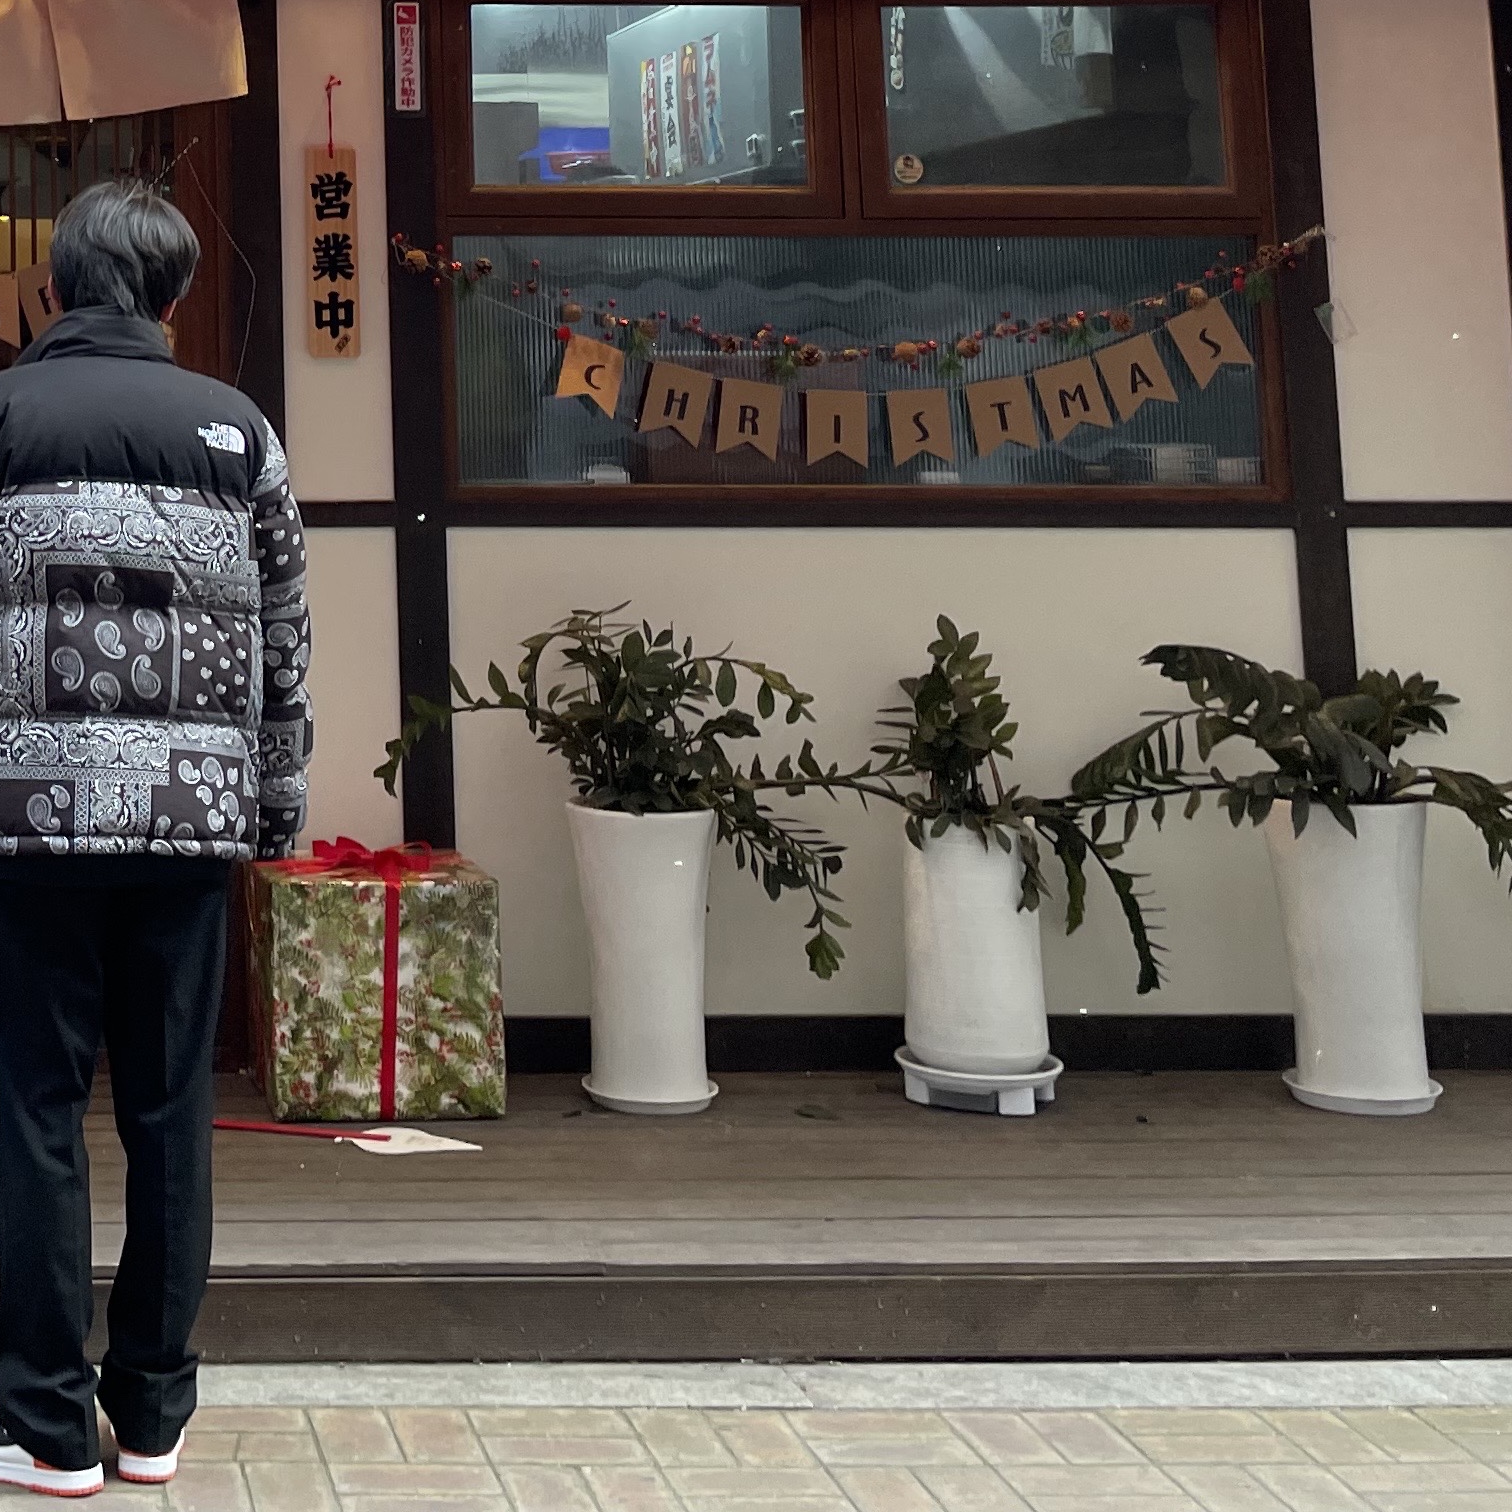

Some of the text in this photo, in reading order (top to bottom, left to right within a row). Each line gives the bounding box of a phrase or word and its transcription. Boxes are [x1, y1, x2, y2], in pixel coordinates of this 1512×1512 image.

[310, 171, 355, 339] 営業中
[584, 326, 1222, 444] CHRISTMAS
[198, 427, 229, 443] NORTH
[210, 422, 229, 433] THE
[206, 437, 229, 450] FACE
